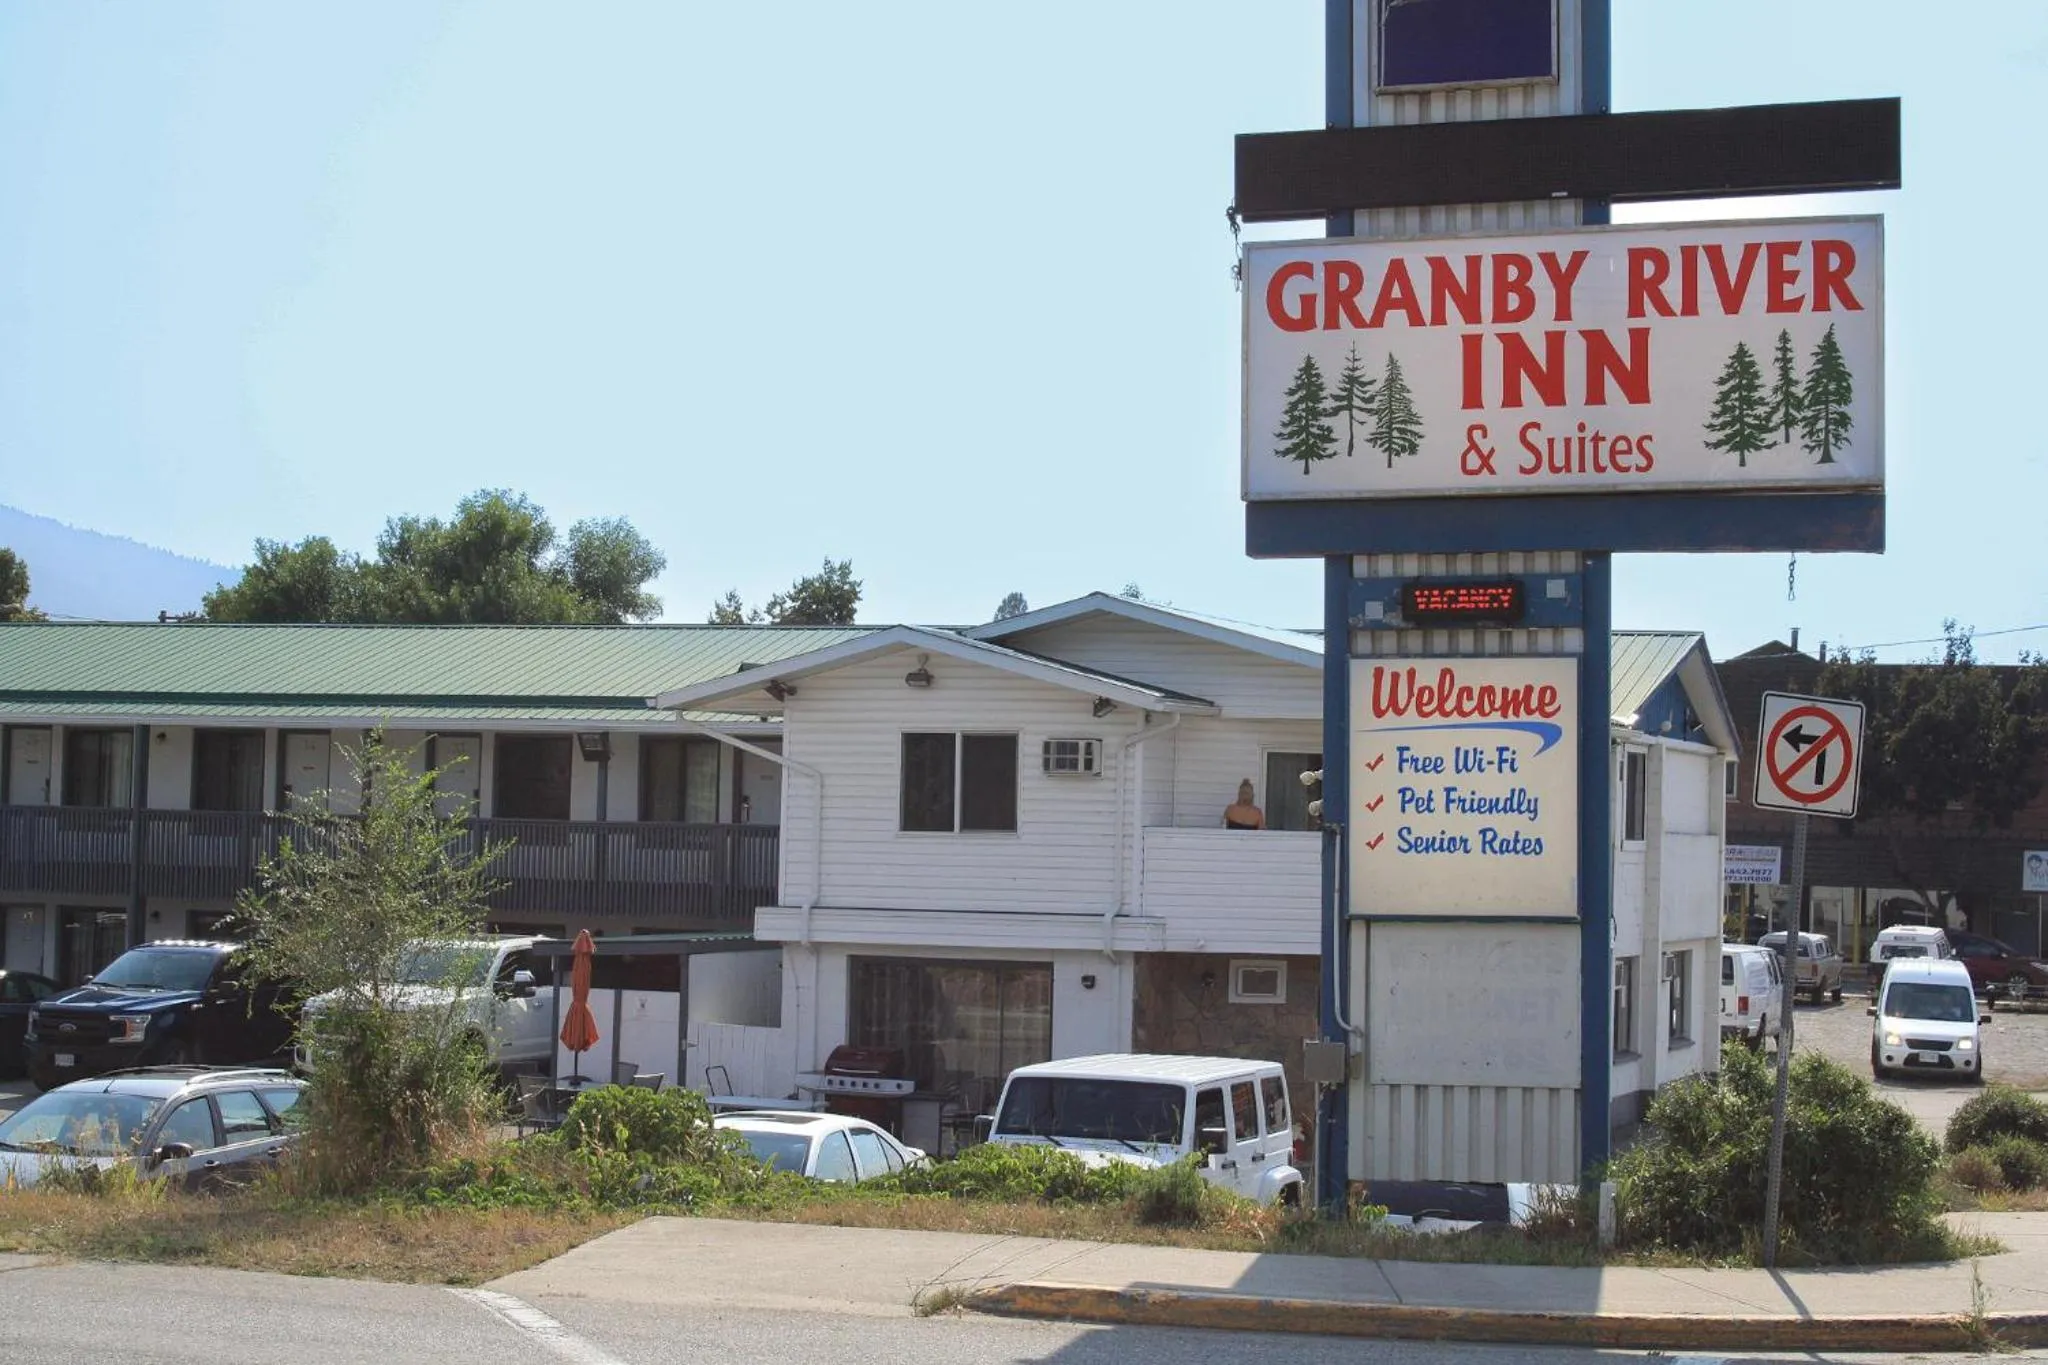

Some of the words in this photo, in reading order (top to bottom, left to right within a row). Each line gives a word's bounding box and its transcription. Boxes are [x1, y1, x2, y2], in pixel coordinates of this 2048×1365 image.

[1266, 250, 1591, 333] GRANBY
[1627, 239, 1864, 319] RIVER
[1461, 327, 1651, 411] INN
[1460, 422, 1497, 477] &
[1518, 421, 1654, 476] Suites
[1414, 588, 1513, 610] VACANCY
[1371, 666, 1561, 719] Welcome
[1396, 745, 1446, 775] Free
[1453, 745, 1519, 774] Wi-Fi
[1397, 786, 1435, 815] Pet
[1443, 785, 1539, 822] Friendly
[1397, 826, 1472, 855] Senior
[1478, 827, 1545, 856] Rates
